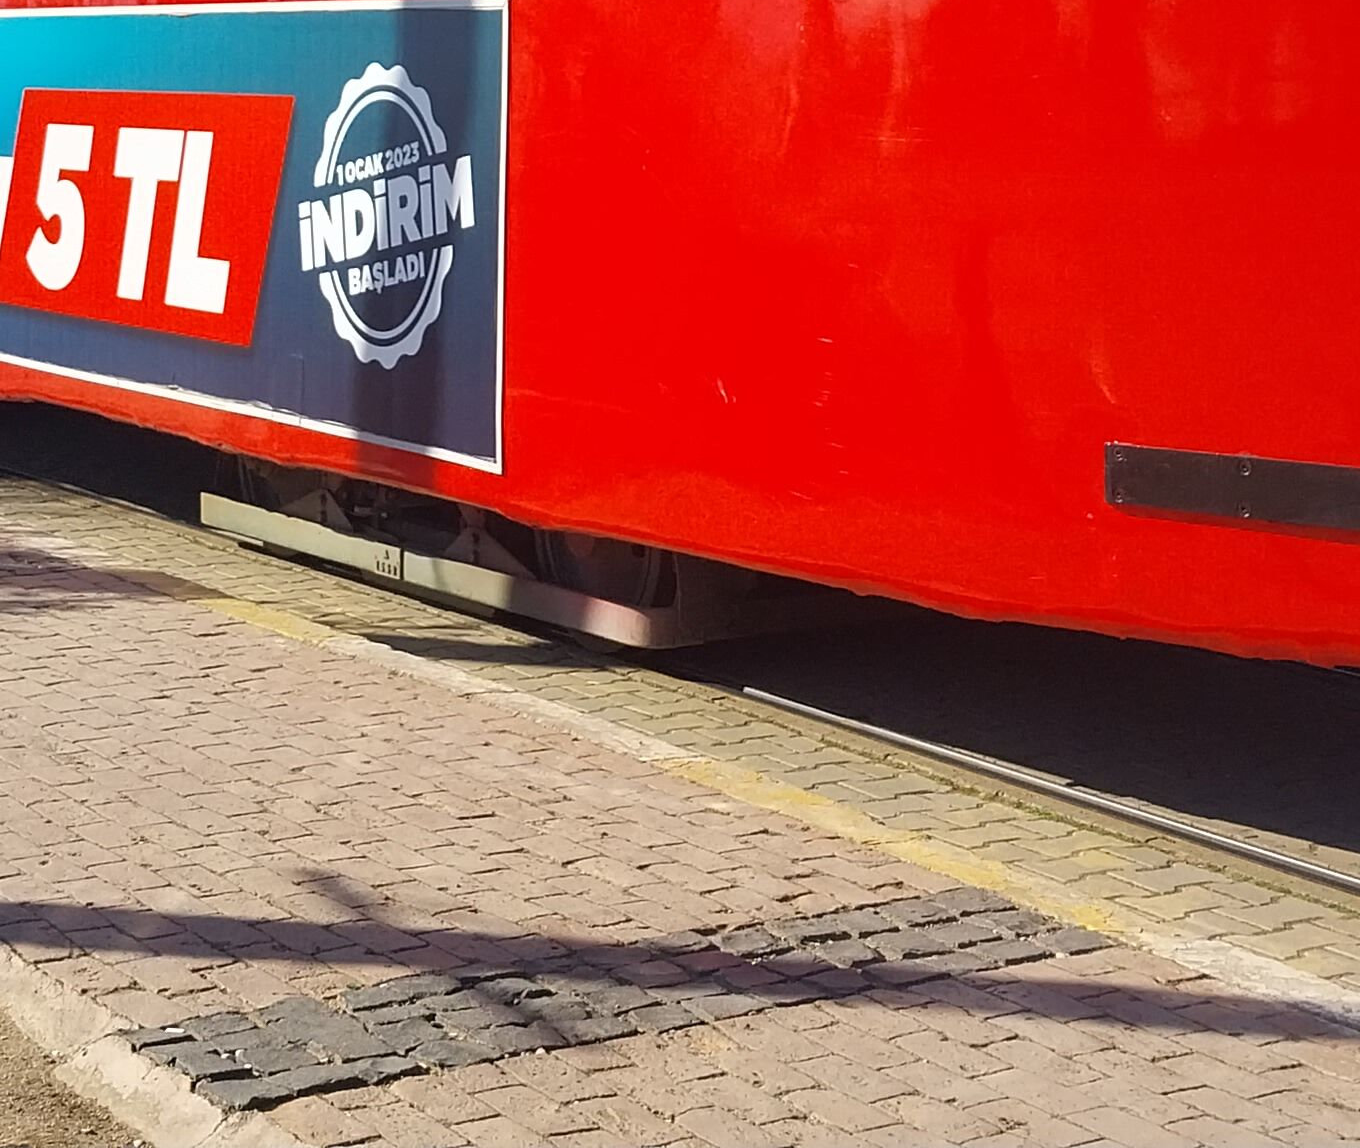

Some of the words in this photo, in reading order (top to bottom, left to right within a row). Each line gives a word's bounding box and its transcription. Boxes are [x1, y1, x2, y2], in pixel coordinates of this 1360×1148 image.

[336, 164, 344, 186] 1
[345, 152, 385, 184] OCAK
[384, 141, 420, 172] 2023
[25, 123, 95, 291] 5
[113, 126, 231, 315] TL
[347, 251, 426, 296] BAŞLADI
